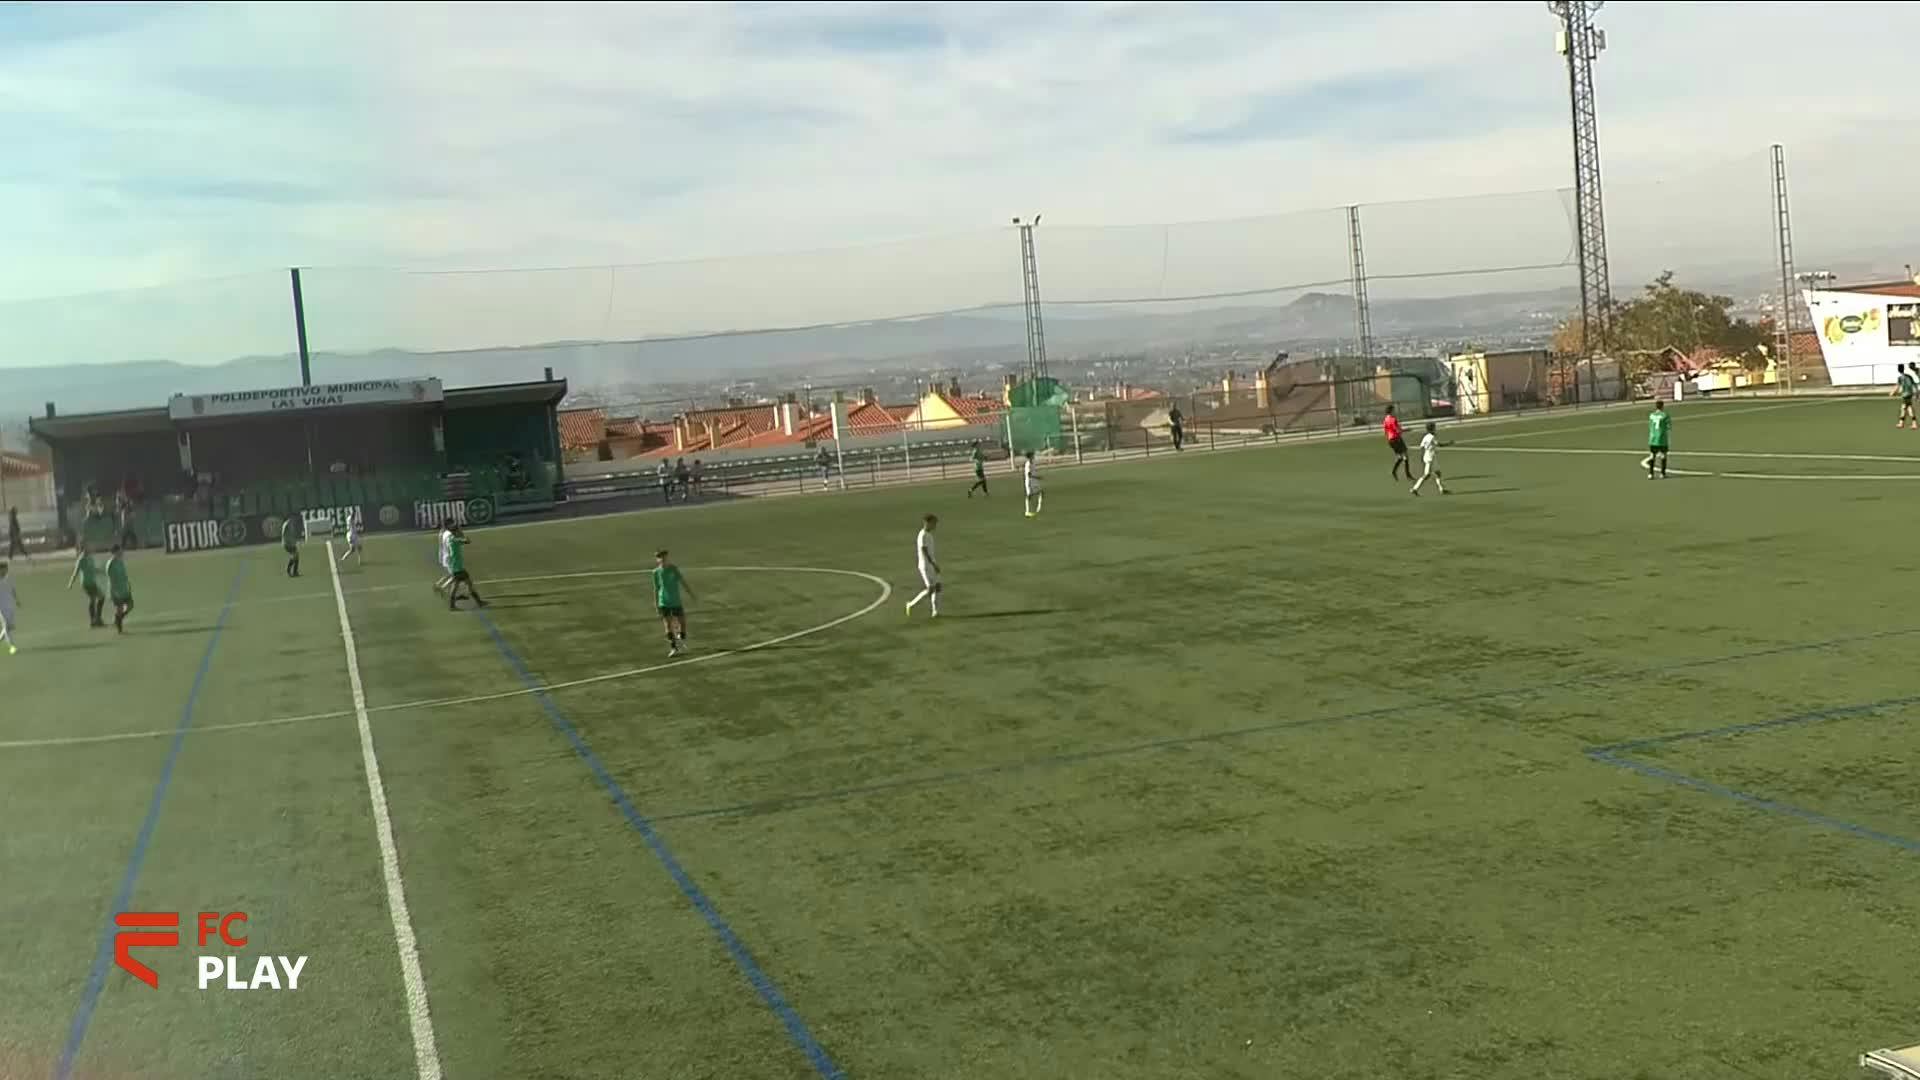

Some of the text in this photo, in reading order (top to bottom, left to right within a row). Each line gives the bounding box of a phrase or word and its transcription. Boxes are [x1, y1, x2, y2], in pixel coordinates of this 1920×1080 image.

[211, 381, 400, 403] POLIDEPORTIVO MUNICIPAL
[271, 398, 296, 409] LAS
